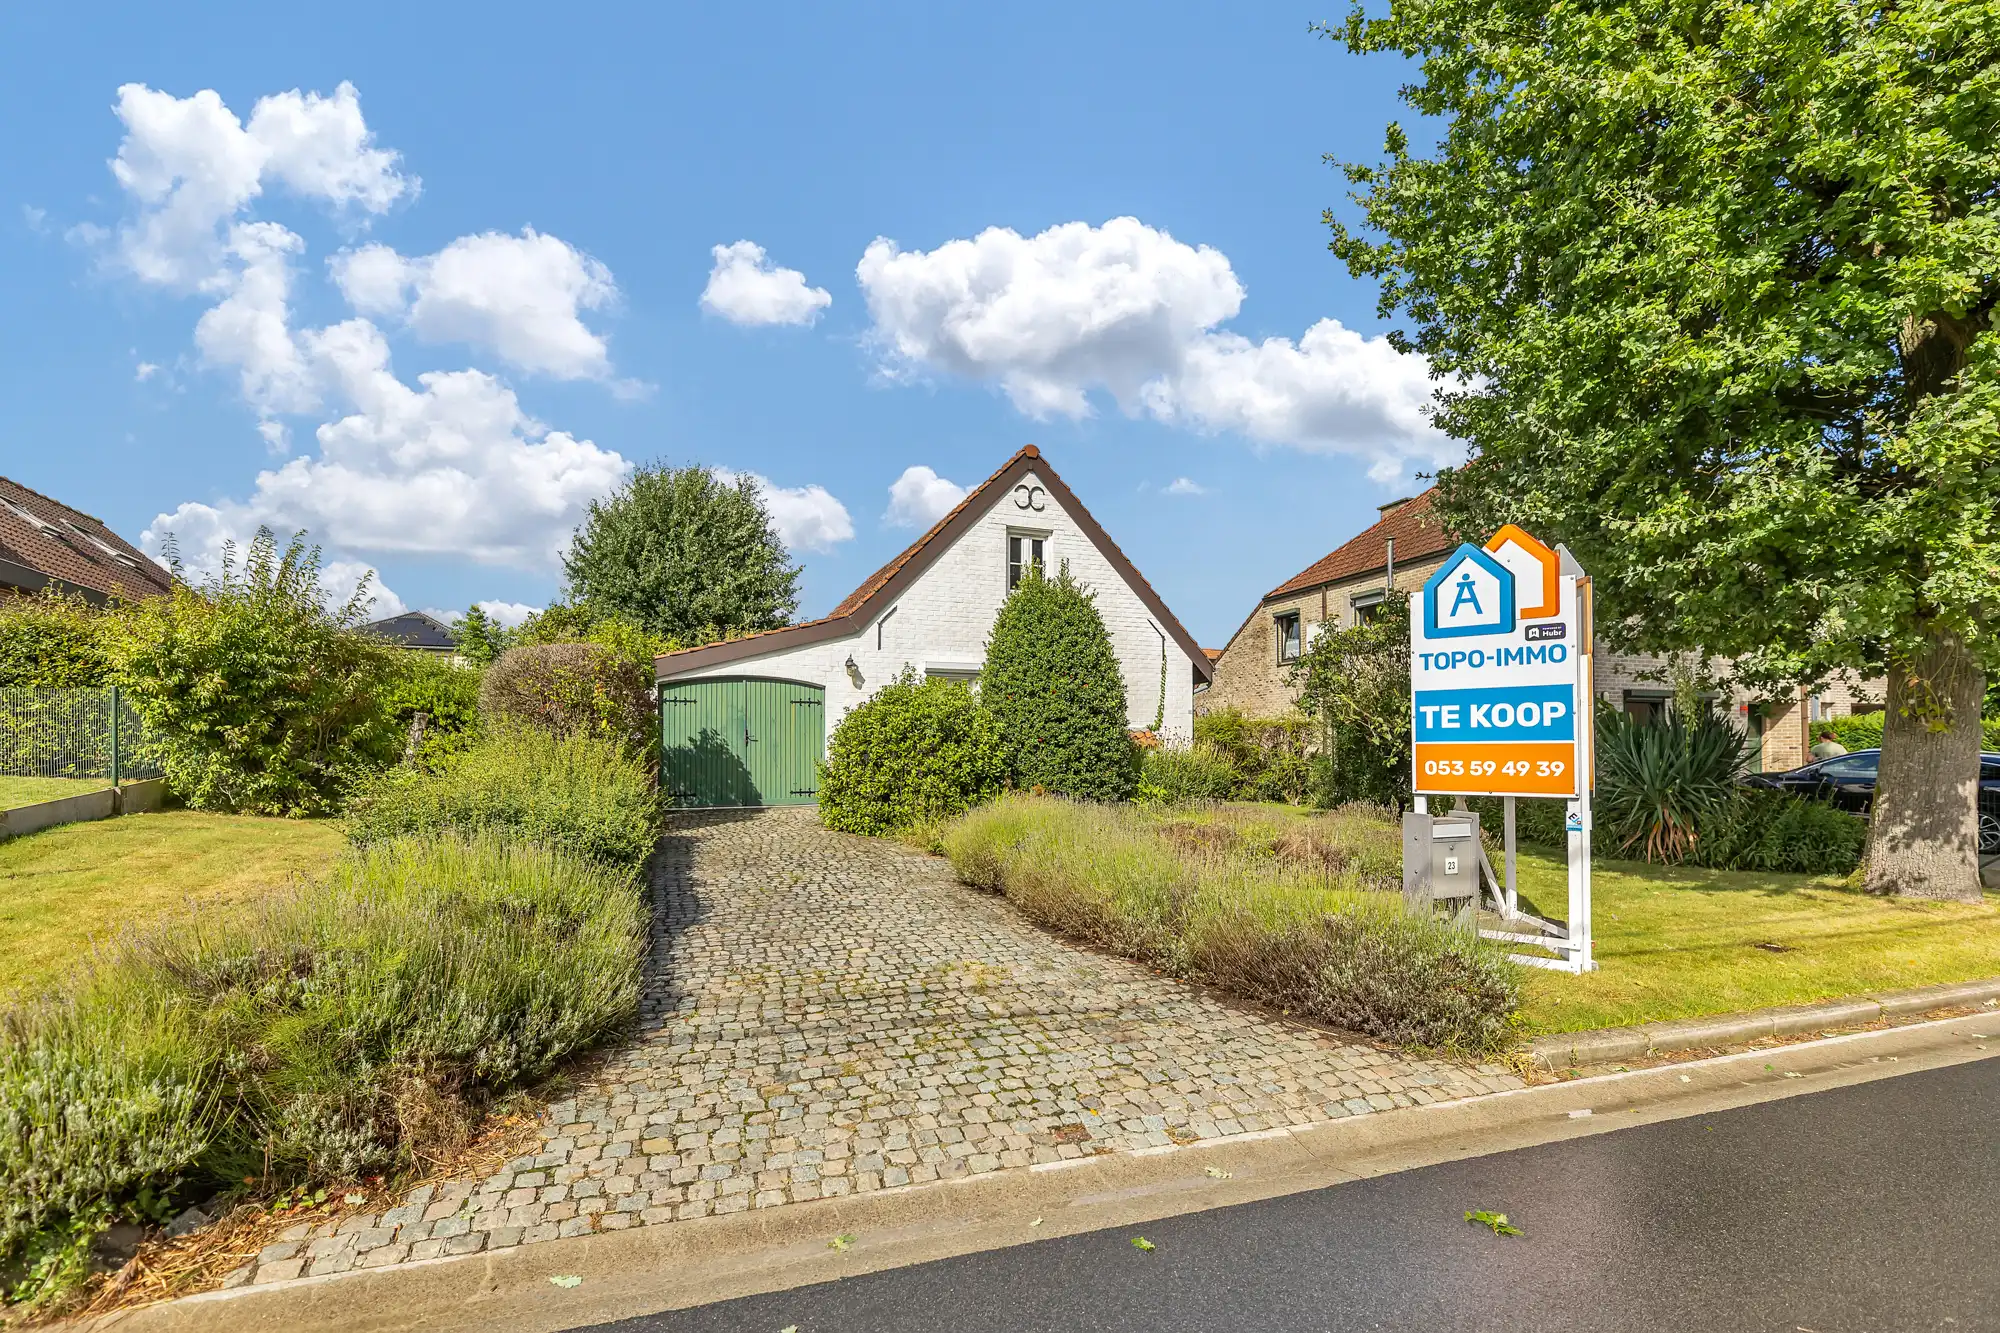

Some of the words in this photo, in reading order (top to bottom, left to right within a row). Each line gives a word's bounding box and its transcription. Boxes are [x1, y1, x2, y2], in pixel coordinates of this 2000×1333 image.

[1542, 629, 1562, 637] Hubr
[1419, 644, 1567, 671] TOPO-IMMO
[1419, 705, 1460, 729] TE
[1470, 701, 1566, 728] KOOP
[1424, 760, 1464, 776] 053
[1469, 760, 1496, 776] 59
[1501, 760, 1530, 777] 49
[1535, 760, 1565, 777] 39
[1447, 861, 1456, 870] 23
